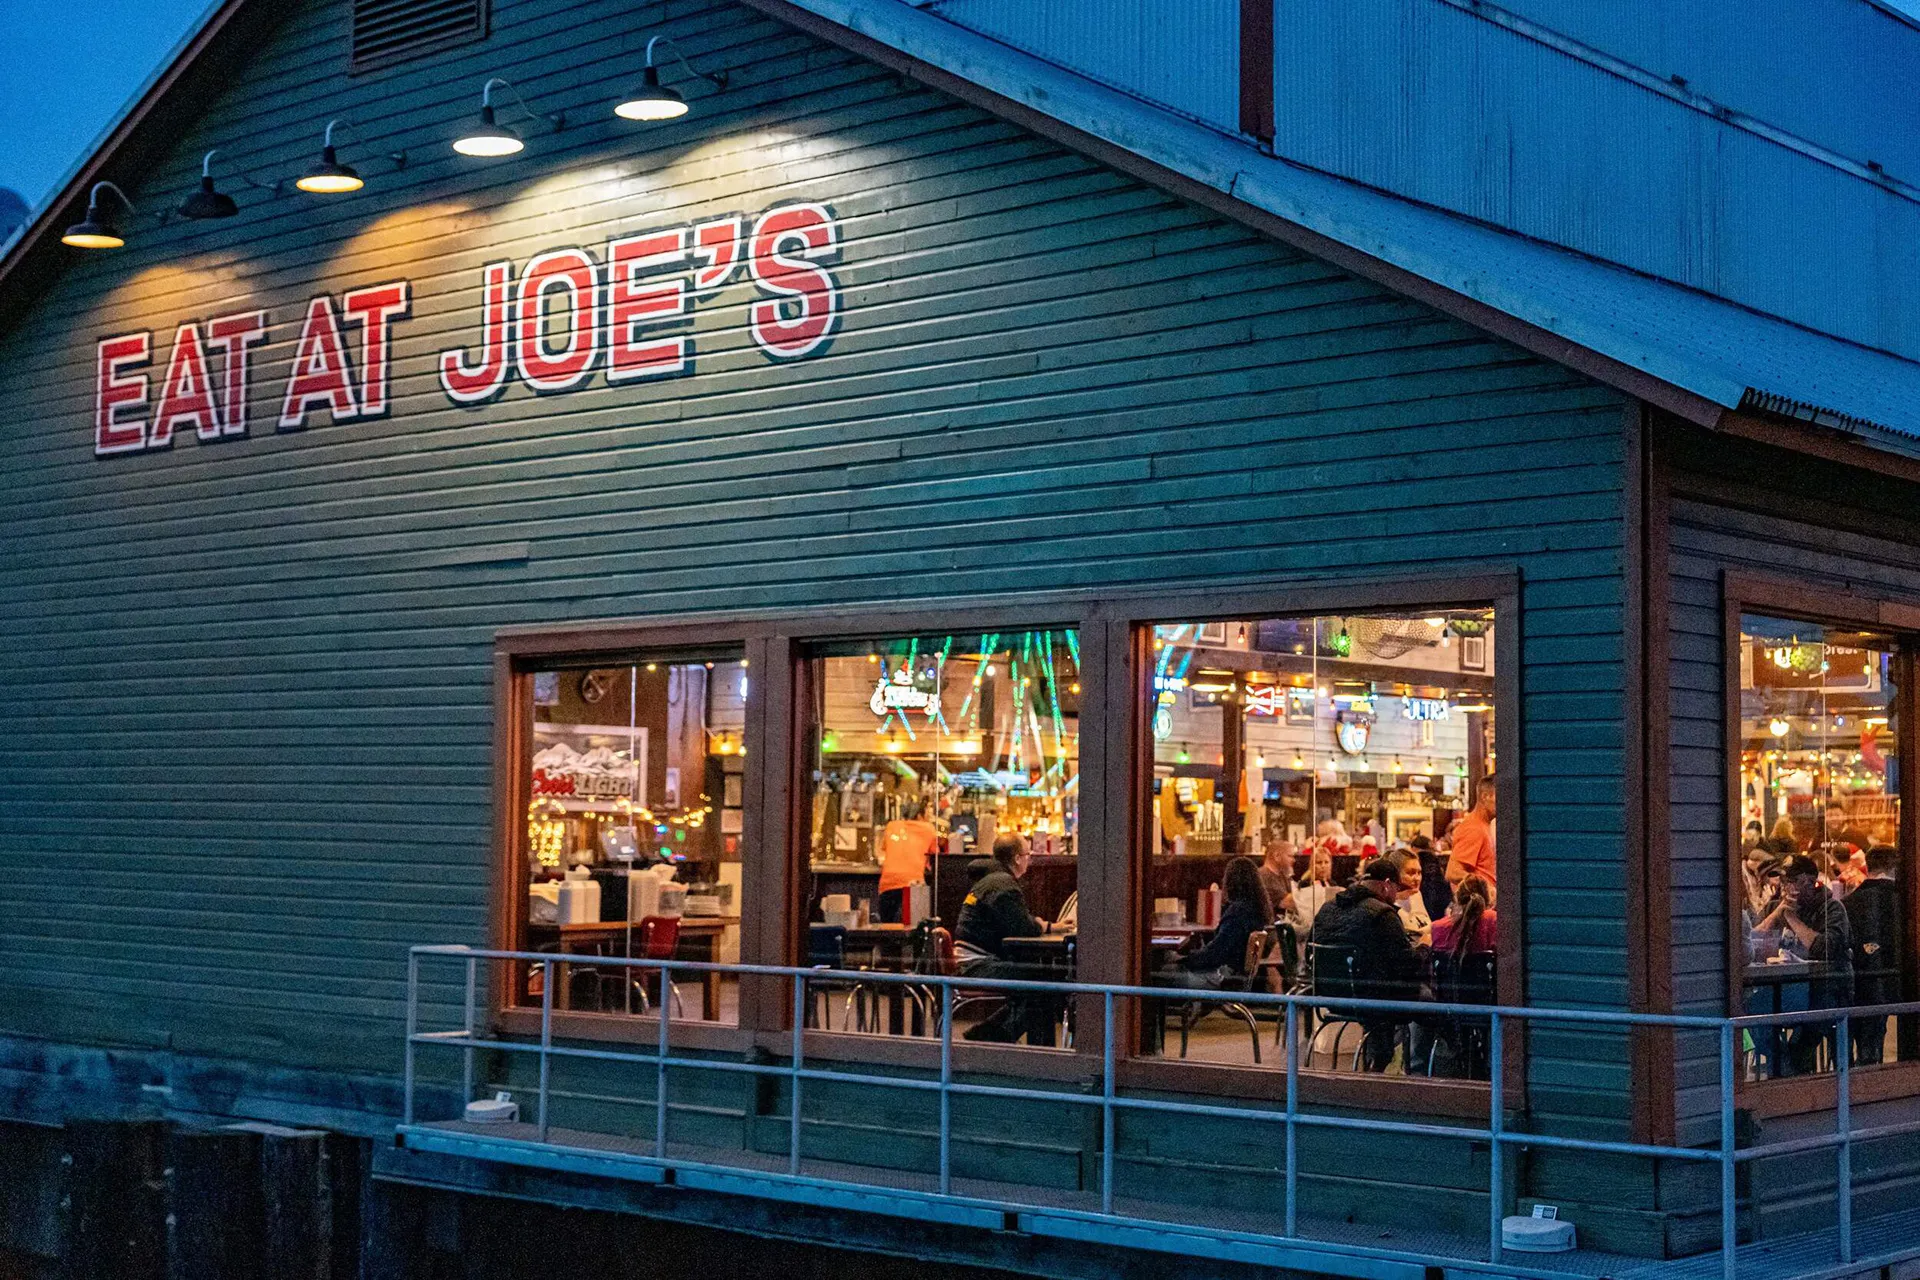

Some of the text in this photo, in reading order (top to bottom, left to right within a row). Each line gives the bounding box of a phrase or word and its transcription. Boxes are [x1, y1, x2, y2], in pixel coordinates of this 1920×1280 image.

[95, 200, 839, 456] EAT AT JOE'S
[1408, 700, 1449, 721] ULTRA
